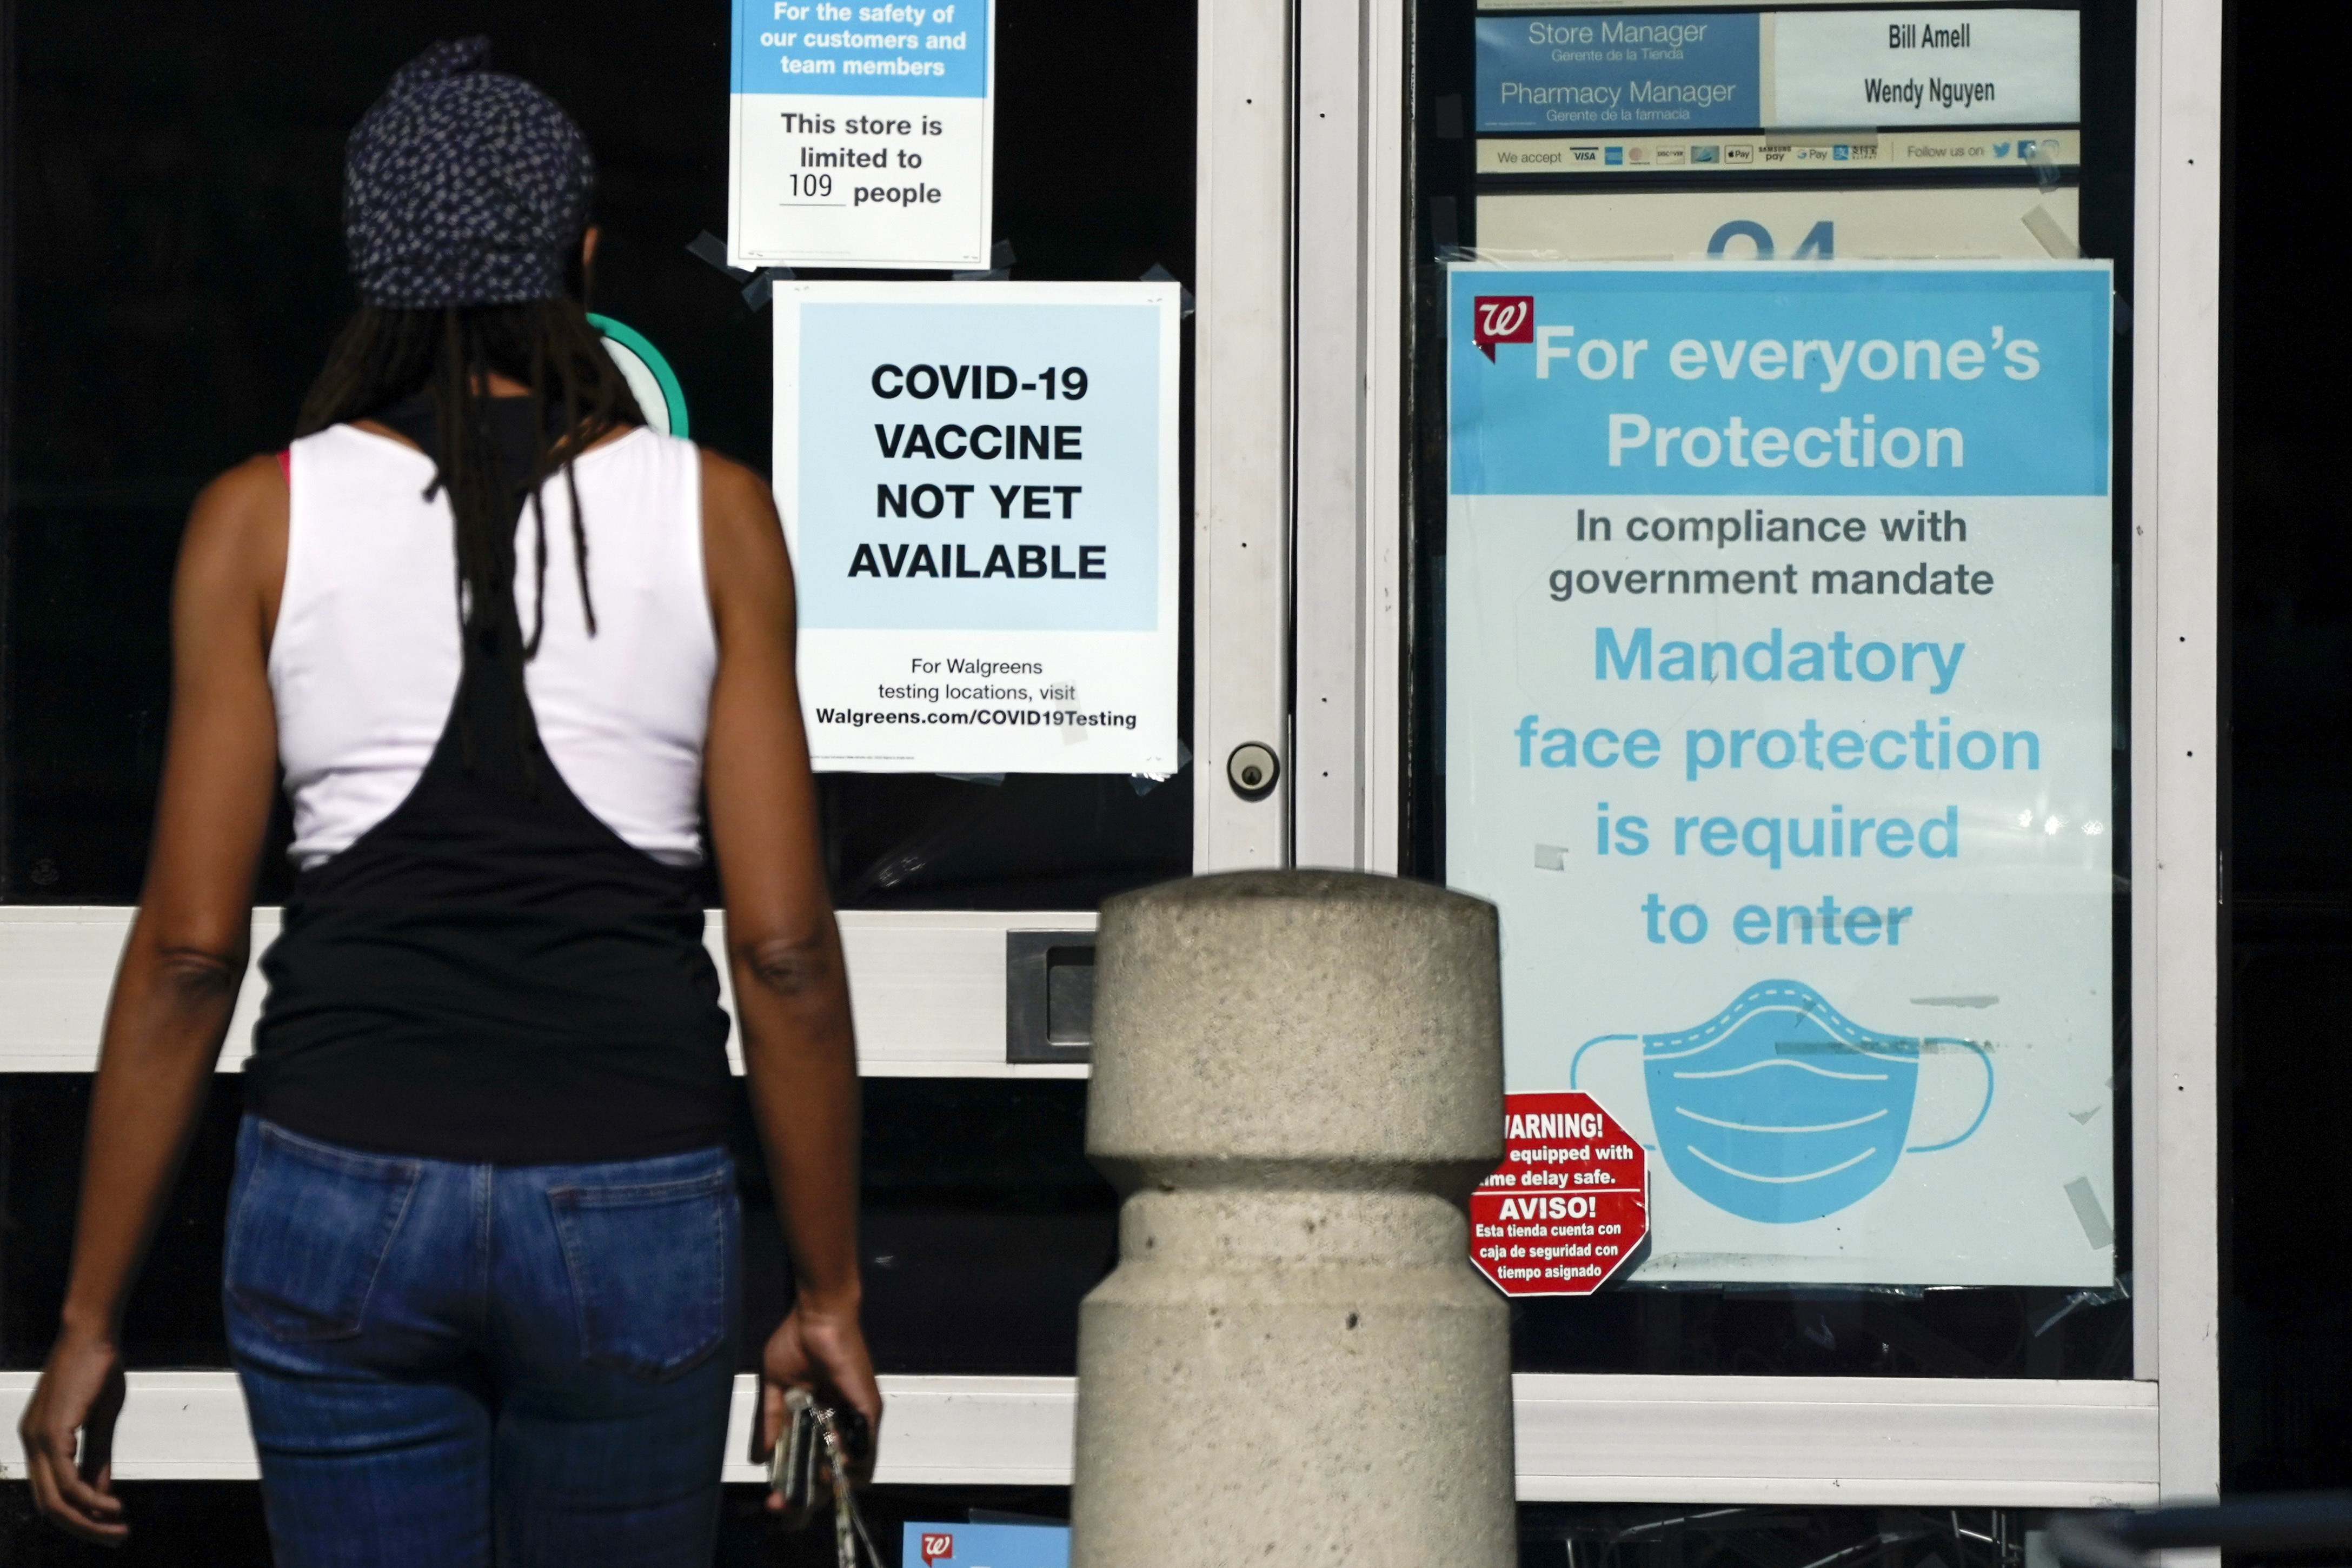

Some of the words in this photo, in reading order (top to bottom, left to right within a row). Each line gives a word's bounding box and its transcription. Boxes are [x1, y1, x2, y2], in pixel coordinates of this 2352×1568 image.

[774, 2, 809, 20] For
[816, 2, 851, 21] the
[859, 4, 925, 25] safety
[933, 5, 955, 23] of
[760, 32, 796, 46] our
[803, 31, 918, 49] customers
[926, 32, 966, 50] and
[1529, 23, 1593, 44] Store
[1602, 22, 1707, 46] Manager
[1889, 24, 1916, 49] Bill
[1922, 23, 1970, 48] Amell
[780, 56, 835, 74] team
[843, 57, 945, 76] members
[1552, 49, 1602, 62] Gerente
[1607, 48, 1622, 61] de
[1626, 48, 1637, 61] la
[1643, 48, 1683, 61] Tienda
[1501, 82, 1621, 107] Pharmacy
[1630, 81, 1736, 107] Manager
[1865, 78, 1924, 108] Wendy
[1929, 77, 1995, 108] Nguyen
[781, 112, 835, 134] This
[845, 116, 911, 135] store
[922, 116, 942, 136] is
[1546, 109, 1597, 122] Gerente
[1602, 109, 1617, 121] de
[1621, 109, 1632, 121] la
[1636, 108, 1690, 120] farmacia
[801, 147, 887, 168] limited
[897, 149, 922, 169] to
[1498, 152, 1518, 163] We
[1522, 152, 1562, 165] accept
[1810, 150, 1827, 160] Pay
[1908, 147, 1946, 158] Follow
[1951, 148, 1965, 157] us
[1968, 147, 1984, 156] on
[789, 174, 832, 197] 109
[854, 183, 941, 207] people
[1535, 325, 1648, 381] For
[871, 363, 1088, 400] COVID-19
[874, 423, 1082, 461] VACCINE
[1607, 413, 1965, 468] Protection
[876, 483, 975, 520] NOT
[989, 484, 1082, 520] YET
[1577, 509, 1612, 542] In
[1626, 509, 1866, 549] compliance
[1881, 511, 1967, 543] with
[847, 543, 1107, 580] AVAILABLE
[1549, 564, 1797, 601] government
[1812, 563, 1995, 596] mandate
[911, 659, 941, 674] For
[946, 659, 1043, 679] Walgreens
[1594, 627, 1966, 695] Mandatory
[878, 684, 939, 702] testing
[945, 684, 1033, 702] locations,
[1040, 686, 1075, 701] visit
[816, 708, 1137, 730] Walgreens.com/COVID19Testing
[1514, 714, 1660, 769] face
[1686, 716, 2041, 781] protection
[1597, 801, 1650, 857] is
[1673, 803, 1959, 869] required
[1642, 893, 1709, 944] to
[1733, 895, 1912, 945] enter
[1510, 1145, 1590, 1165] equipped
[1594, 1145, 1633, 1159] with
[1479, 1174, 1516, 1186] ime
[1522, 1171, 1569, 1188] delay
[1574, 1169, 1616, 1184] safe.
[1499, 1197, 1596, 1220] AVISO!
[1476, 1224, 1504, 1237] Esta
[1507, 1224, 1547, 1237] tienda
[1551, 1223, 1594, 1235] cuenta
[1598, 1224, 1622, 1234] con
[1480, 1245, 1506, 1261] caja
[1510, 1245, 1525, 1257] de
[1530, 1244, 1591, 1260] seguridad
[1596, 1245, 1618, 1256] con
[1498, 1266, 1541, 1281] tiempo
[1545, 1265, 1602, 1280] asignado
